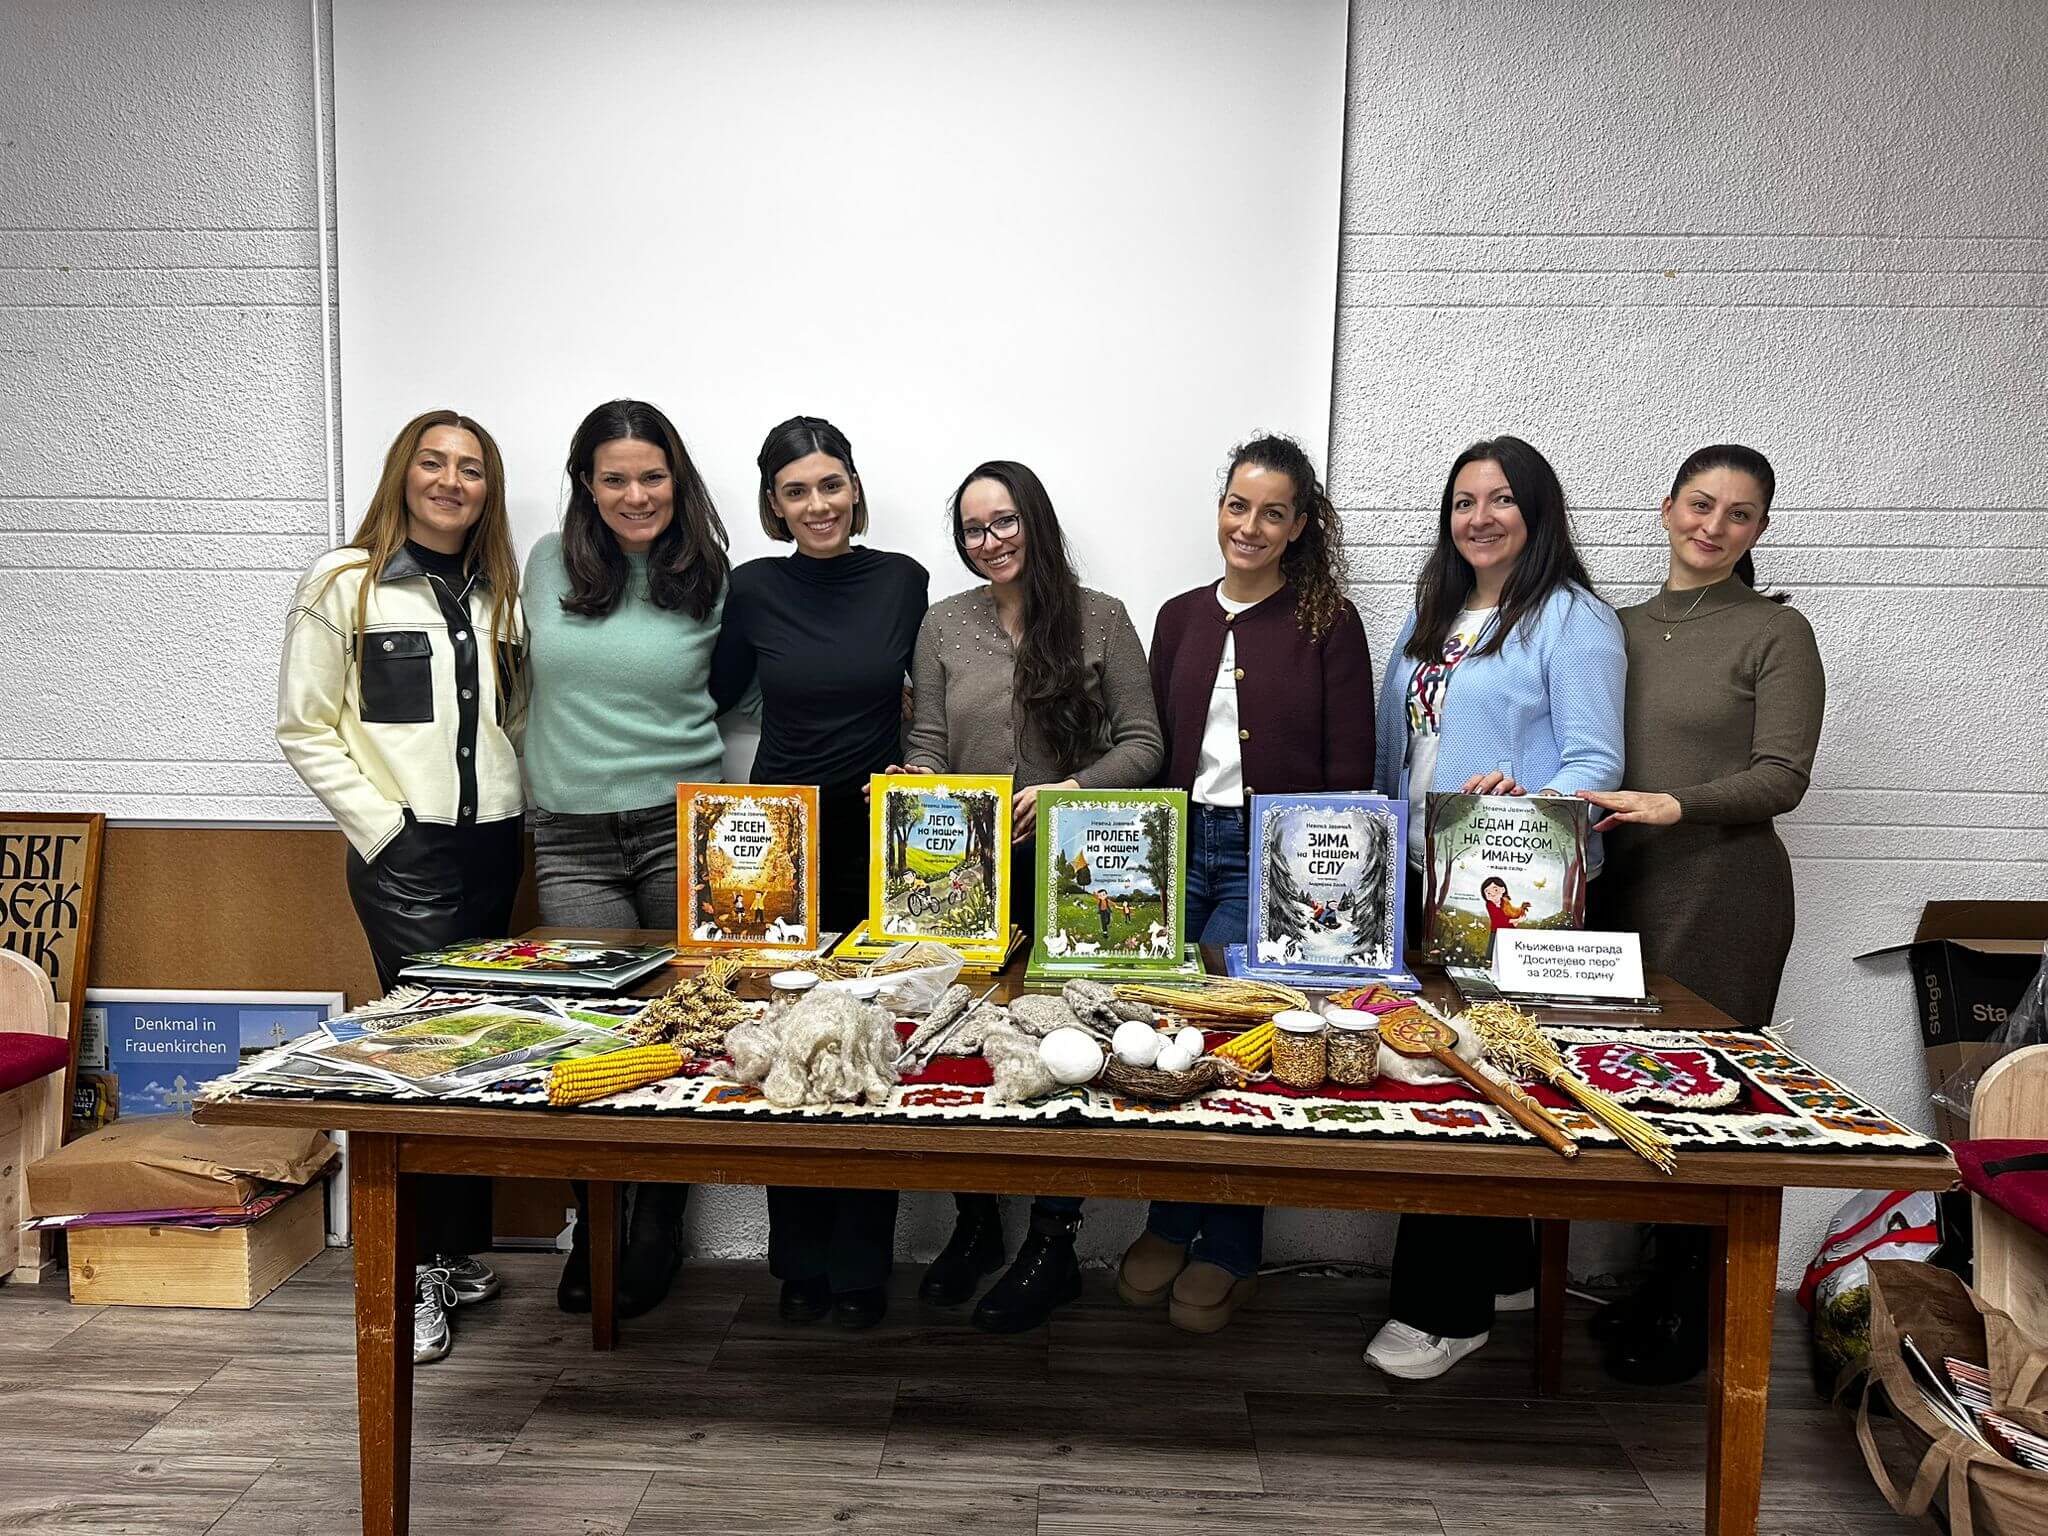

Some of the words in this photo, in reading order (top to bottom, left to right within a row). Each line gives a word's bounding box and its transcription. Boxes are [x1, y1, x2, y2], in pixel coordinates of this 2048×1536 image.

[730, 820, 766, 833] ЈЕСЕН
[927, 814, 955, 826] ЛЕТО
[1469, 817, 1514, 832] ЈЕДАН
[1518, 820, 1549, 833] ДАН
[724, 834, 737, 842] на
[740, 834, 772, 843] нашем
[932, 828, 964, 837] нашем
[1086, 829, 1140, 842] ПРОЛЕЋЕ
[926, 838, 957, 851] СЕЛУ
[1308, 832, 1349, 848] ЗИМА
[1463, 832, 1481, 845] НА
[1485, 834, 1553, 850] СЕОСКОМ
[733, 845, 763, 858] СЕЛУ
[1086, 844, 1100, 853] на
[1104, 844, 1140, 853] нашем
[1312, 848, 1360, 860] нашем
[1096, 855, 1130, 869] СЕЛУ
[1481, 848, 1534, 865] ИМАЊУ
[1308, 860, 1345, 875] СЕЛУ
[1514, 940, 1575, 953] Књижевна
[1577, 945, 1623, 955] награда
[1518, 954, 1586, 967] "Доситејево
[1588, 957, 1621, 968] перо"
[1527, 968, 1540, 978] за
[1542, 968, 1573, 979] 2025.
[1575, 970, 1615, 982] годину
[1925, 974, 1942, 1036] Stagg
[1972, 1003, 2008, 1023] Sta
[134, 1017, 198, 1031] Denkmal
[202, 1018, 216, 1031] in
[125, 1039, 226, 1053] Frauenkirchen
